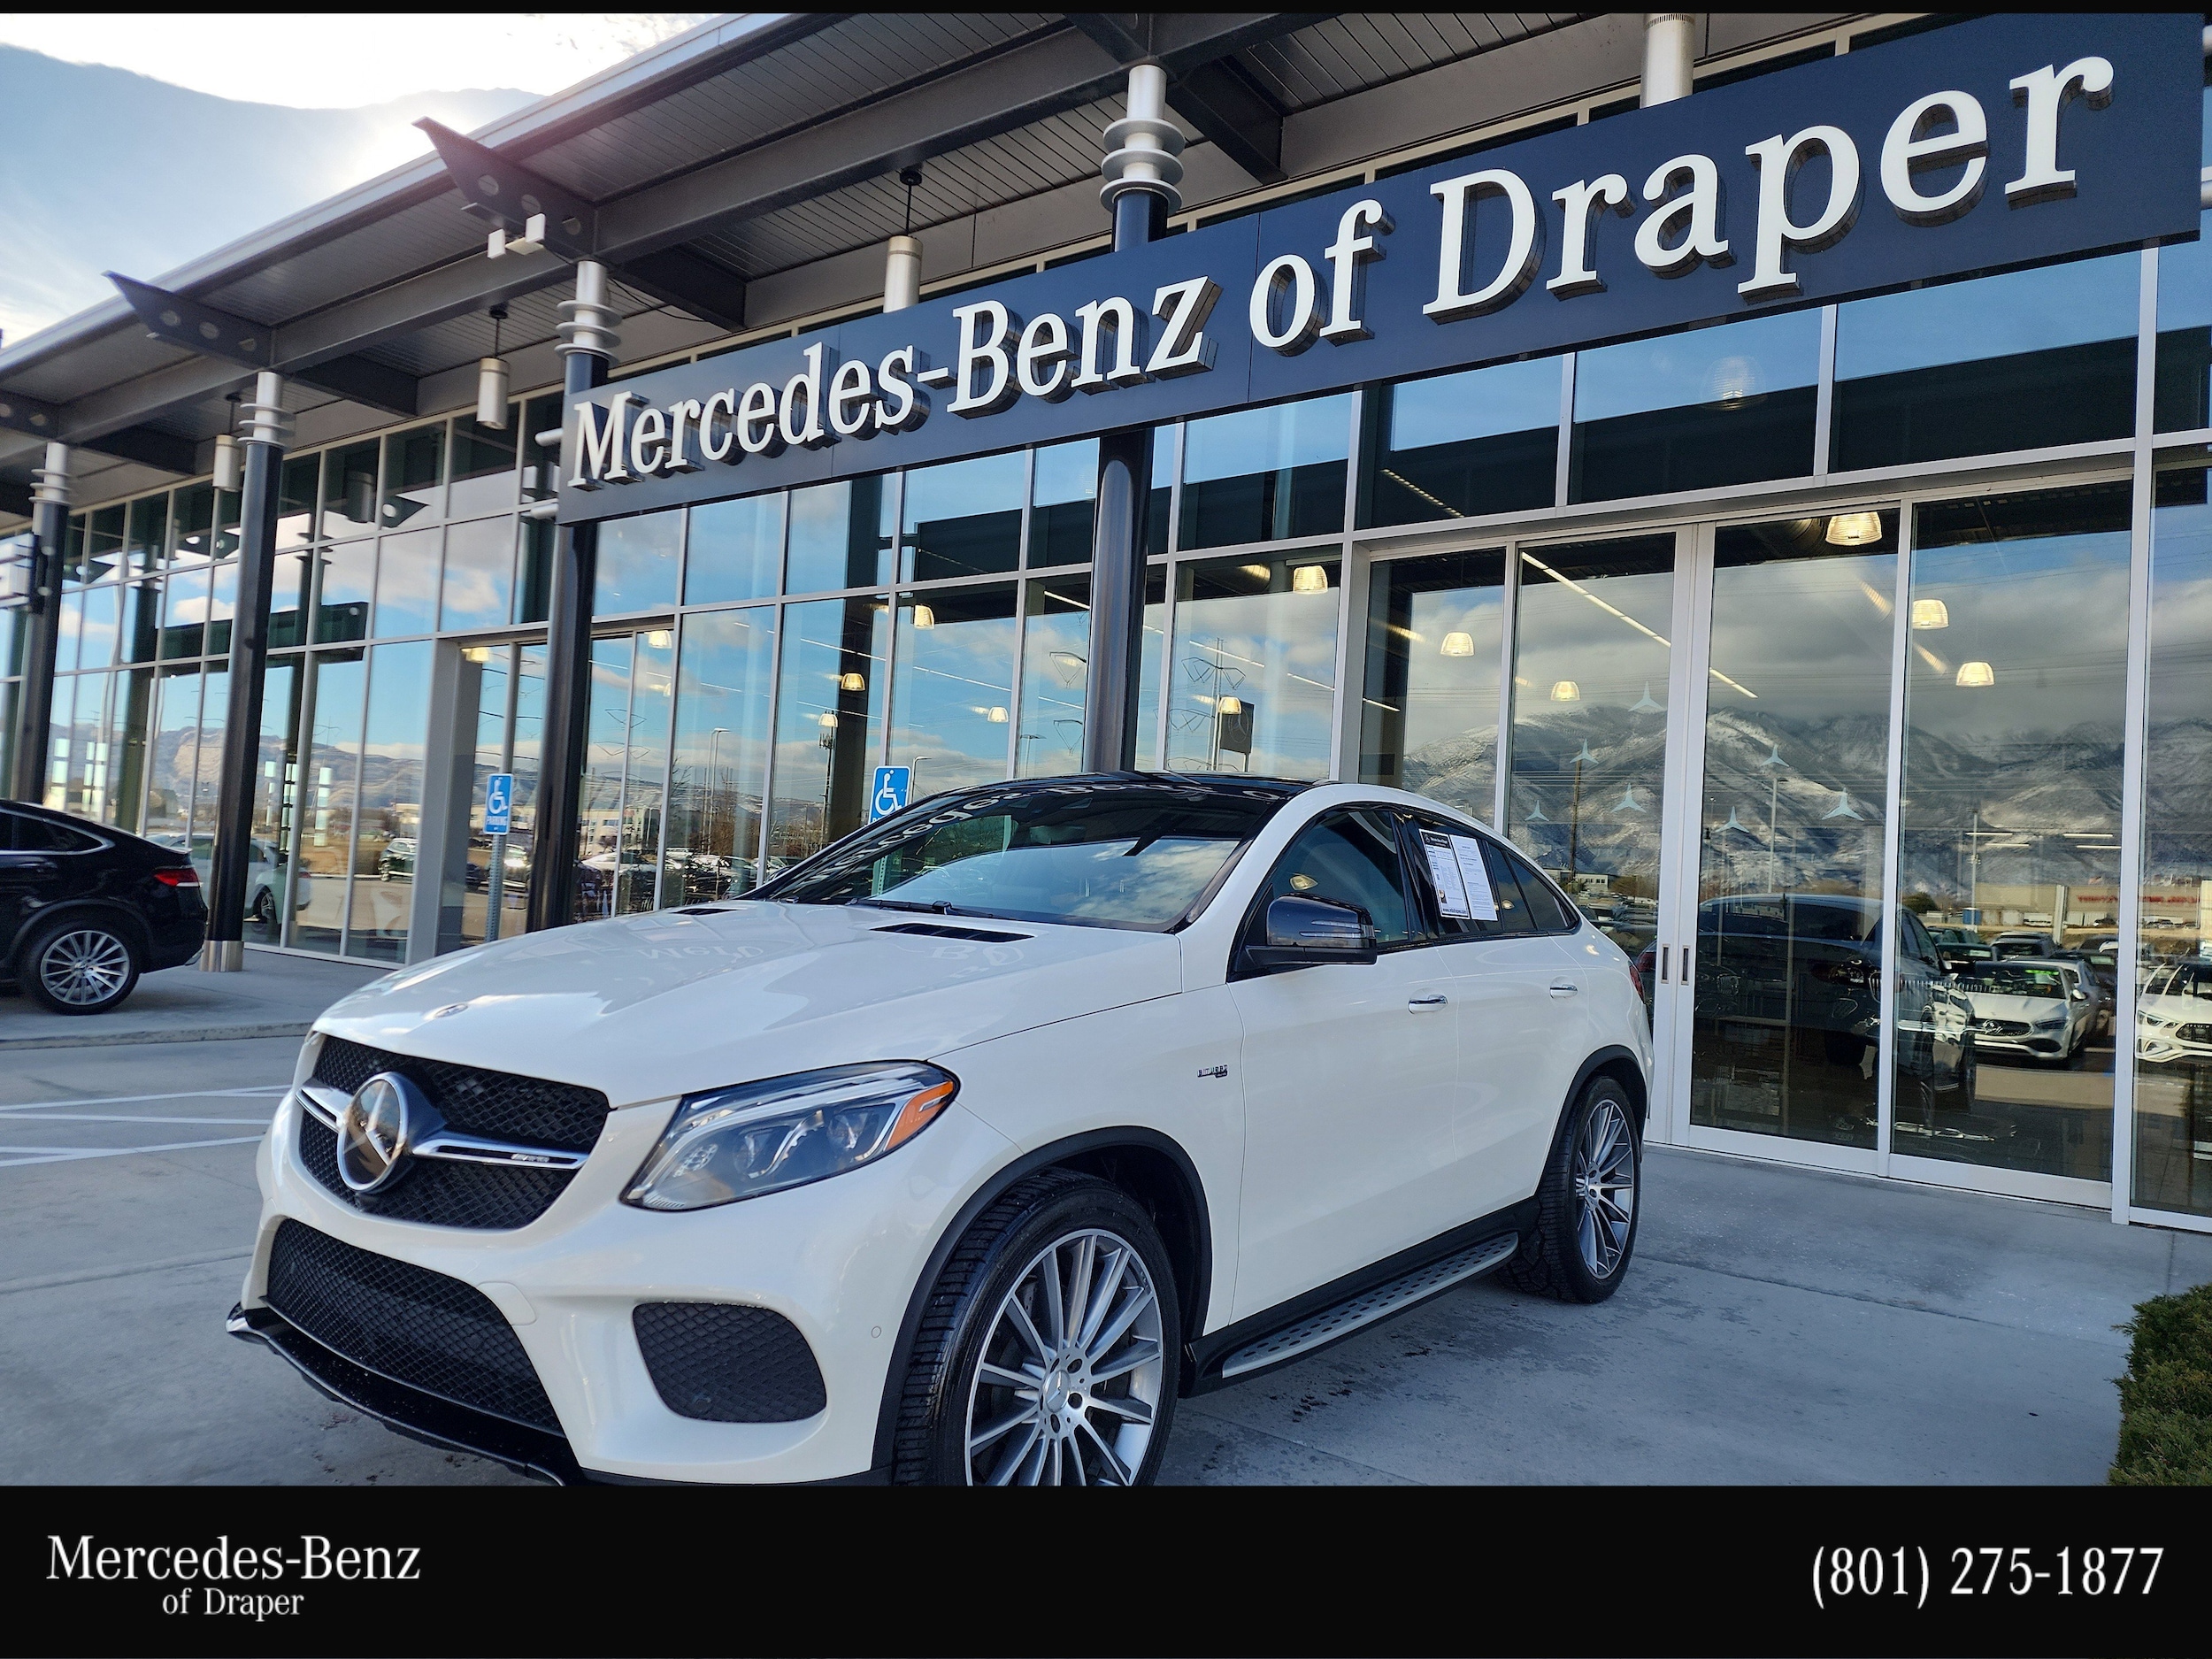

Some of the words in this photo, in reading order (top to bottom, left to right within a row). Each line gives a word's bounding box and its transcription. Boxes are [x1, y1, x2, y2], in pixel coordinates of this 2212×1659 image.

[566, 275, 1215, 490] Mercedes-Benz
[1249, 199, 1384, 352] of
[1422, 55, 2115, 315] Draper
